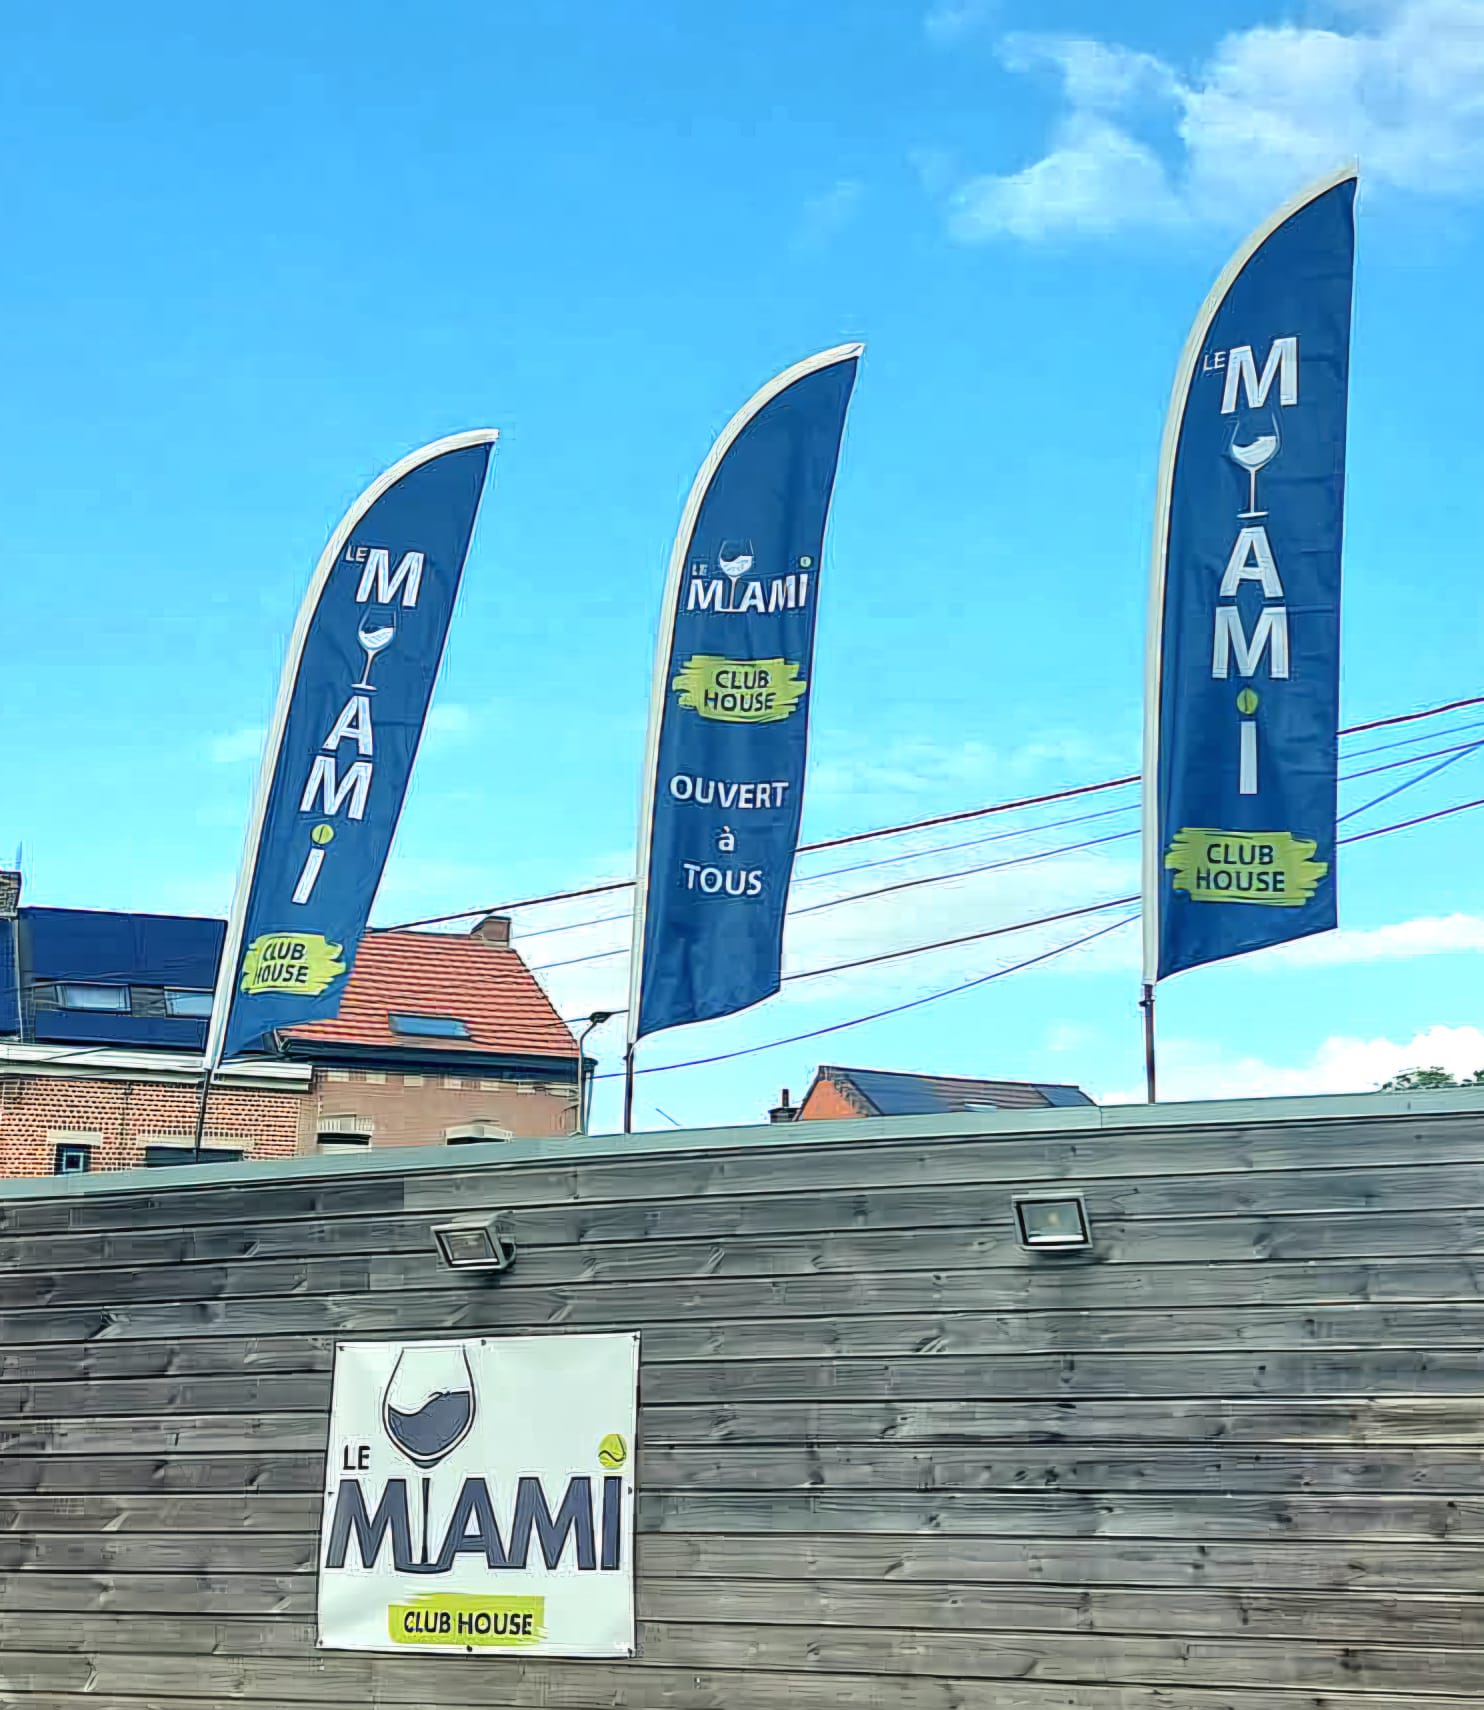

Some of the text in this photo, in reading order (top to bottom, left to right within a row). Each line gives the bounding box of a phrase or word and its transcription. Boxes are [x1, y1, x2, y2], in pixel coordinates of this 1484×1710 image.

[1203, 351, 1226, 371] LE
[345, 545, 368, 562] LE
[692, 563, 708, 576] LE
[715, 669, 771, 690] CLUB
[703, 689, 776, 712] HOUSE
[670, 775, 789, 809] OUVERT
[718, 825, 735, 851] à
[1206, 843, 1274, 866] CLUB
[683, 863, 763, 896] TOUS
[1196, 867, 1286, 892] HOUSE
[261, 942, 306, 962] CLUB
[253, 963, 309, 986] HOUSE
[342, 1445, 371, 1471] LE
[403, 1611, 533, 1635] CLUB HOUSE
